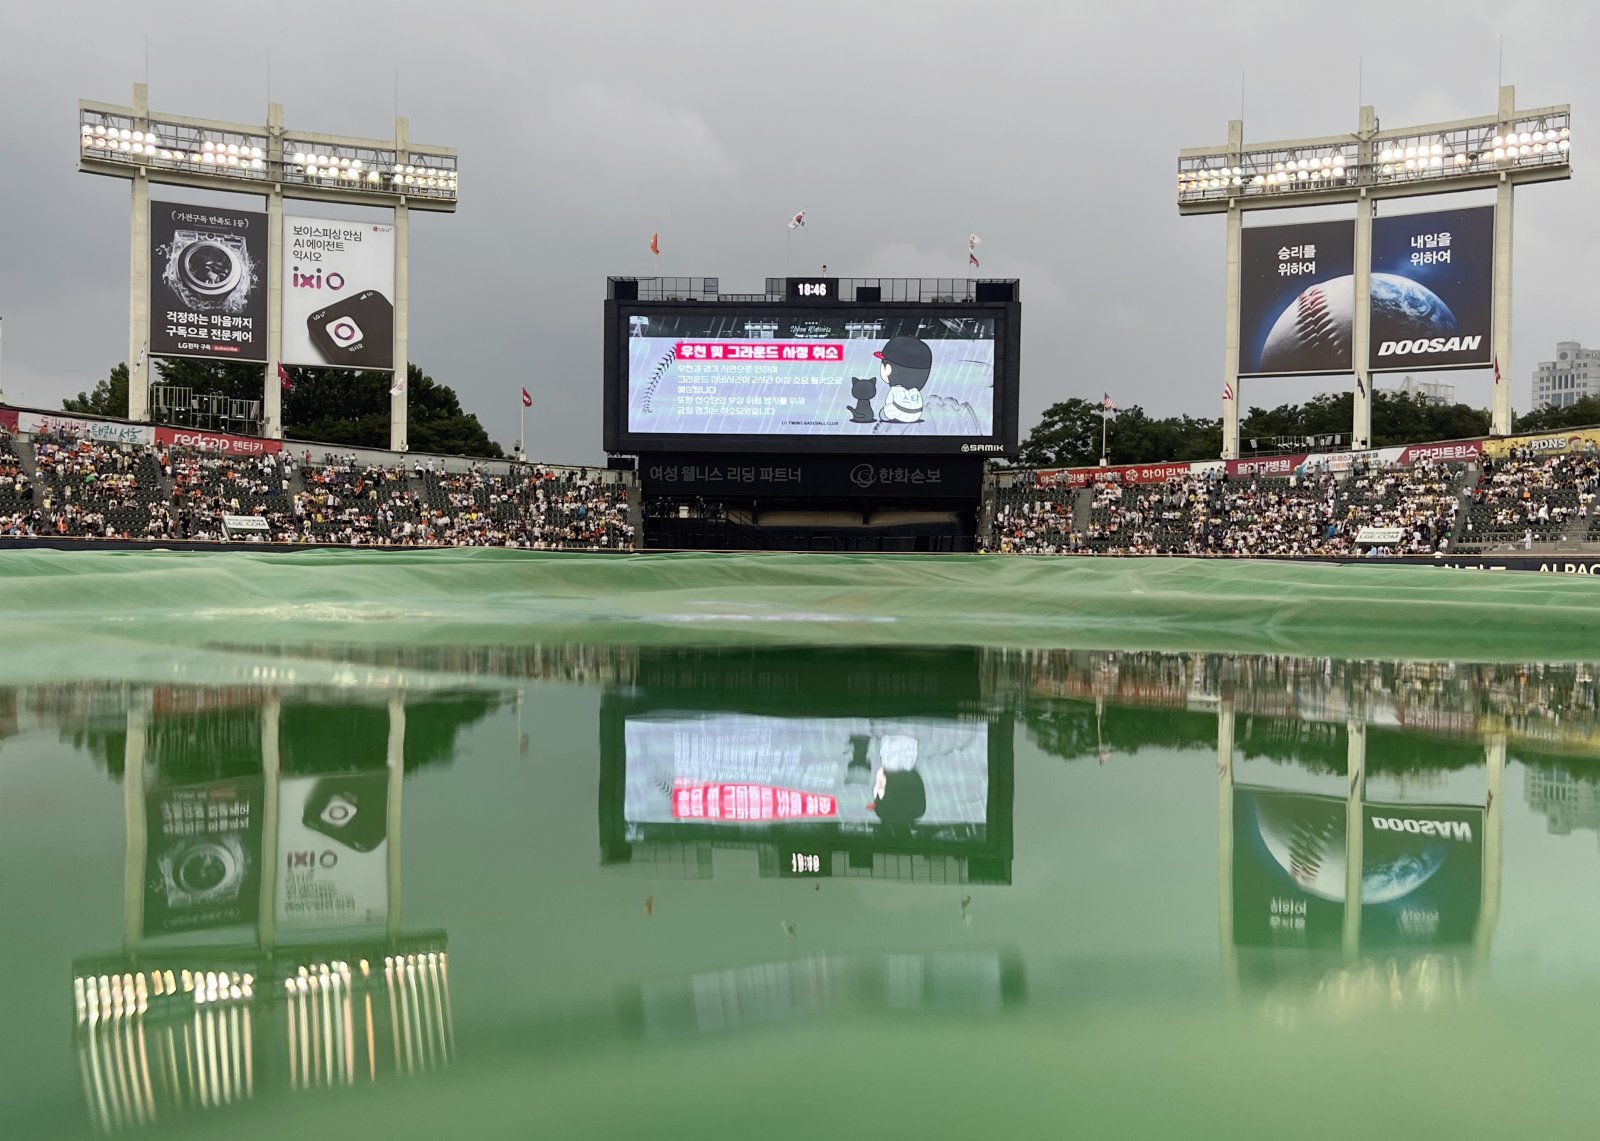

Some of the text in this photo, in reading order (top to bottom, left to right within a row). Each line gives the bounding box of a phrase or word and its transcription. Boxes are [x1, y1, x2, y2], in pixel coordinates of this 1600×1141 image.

[209, 216, 231, 226] 만족도
[293, 226, 362, 242] 보이스피싱 안심
[1410, 232, 1452, 249] 내일을
[293, 238, 345, 251] AI 에이전트
[1277, 244, 1316, 260] 승리를
[293, 250, 322, 262] 익시오
[1410, 249, 1451, 266] 위하여
[1277, 261, 1316, 277] 위하여
[798, 283, 827, 296] 18:46
[166, 311, 252, 329] 걱정하는 마음까지
[166, 325, 252, 343] 구독으로 전문케어
[200, 343, 211, 351] 구독
[681, 345, 839, 359] 우천 및 그라운드 사정 취소
[1377, 335, 1482, 357] DOOSAN
[677, 376, 709, 384] 그라운드
[792, 376, 809, 384] 소요
[91, 424, 117, 438] 특별시
[119, 427, 143, 442] 서울
[969, 444, 1004, 452] SAMIK
[1530, 438, 1567, 451] BDNS
[650, 466, 802, 482] 여성 웰니스 리딩 파트너
[879, 468, 942, 484] 한화손보
